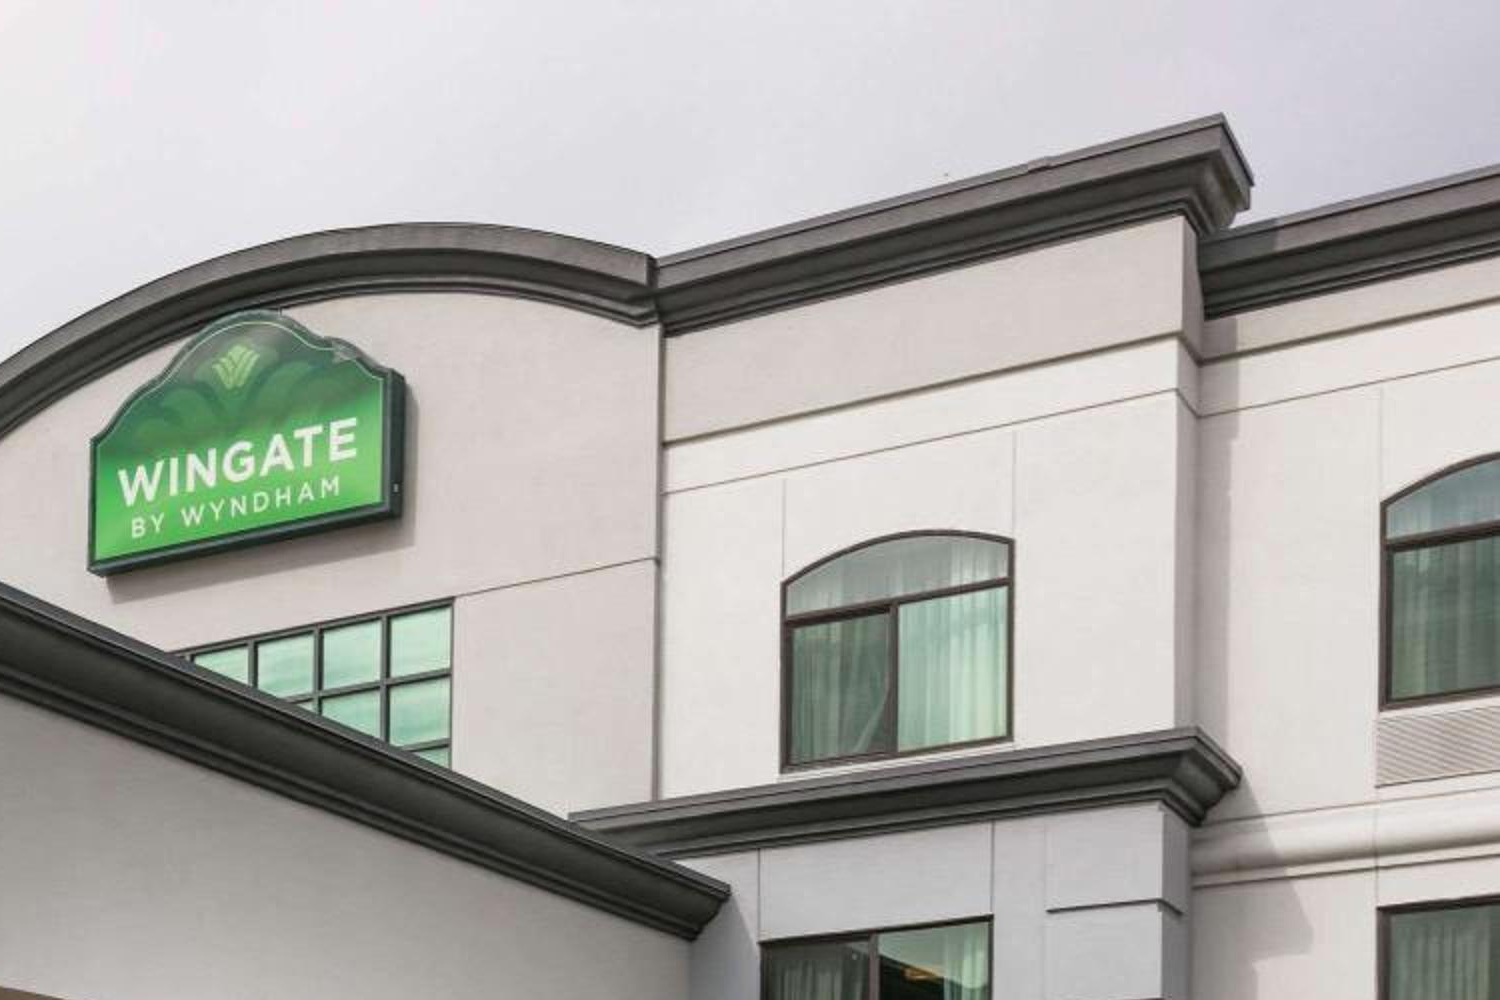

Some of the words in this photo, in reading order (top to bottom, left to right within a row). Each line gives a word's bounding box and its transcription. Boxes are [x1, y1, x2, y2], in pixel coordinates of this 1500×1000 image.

[117, 417, 357, 507] WINGATE
[131, 513, 165, 539] BY
[181, 475, 340, 528] WYNDHAM
